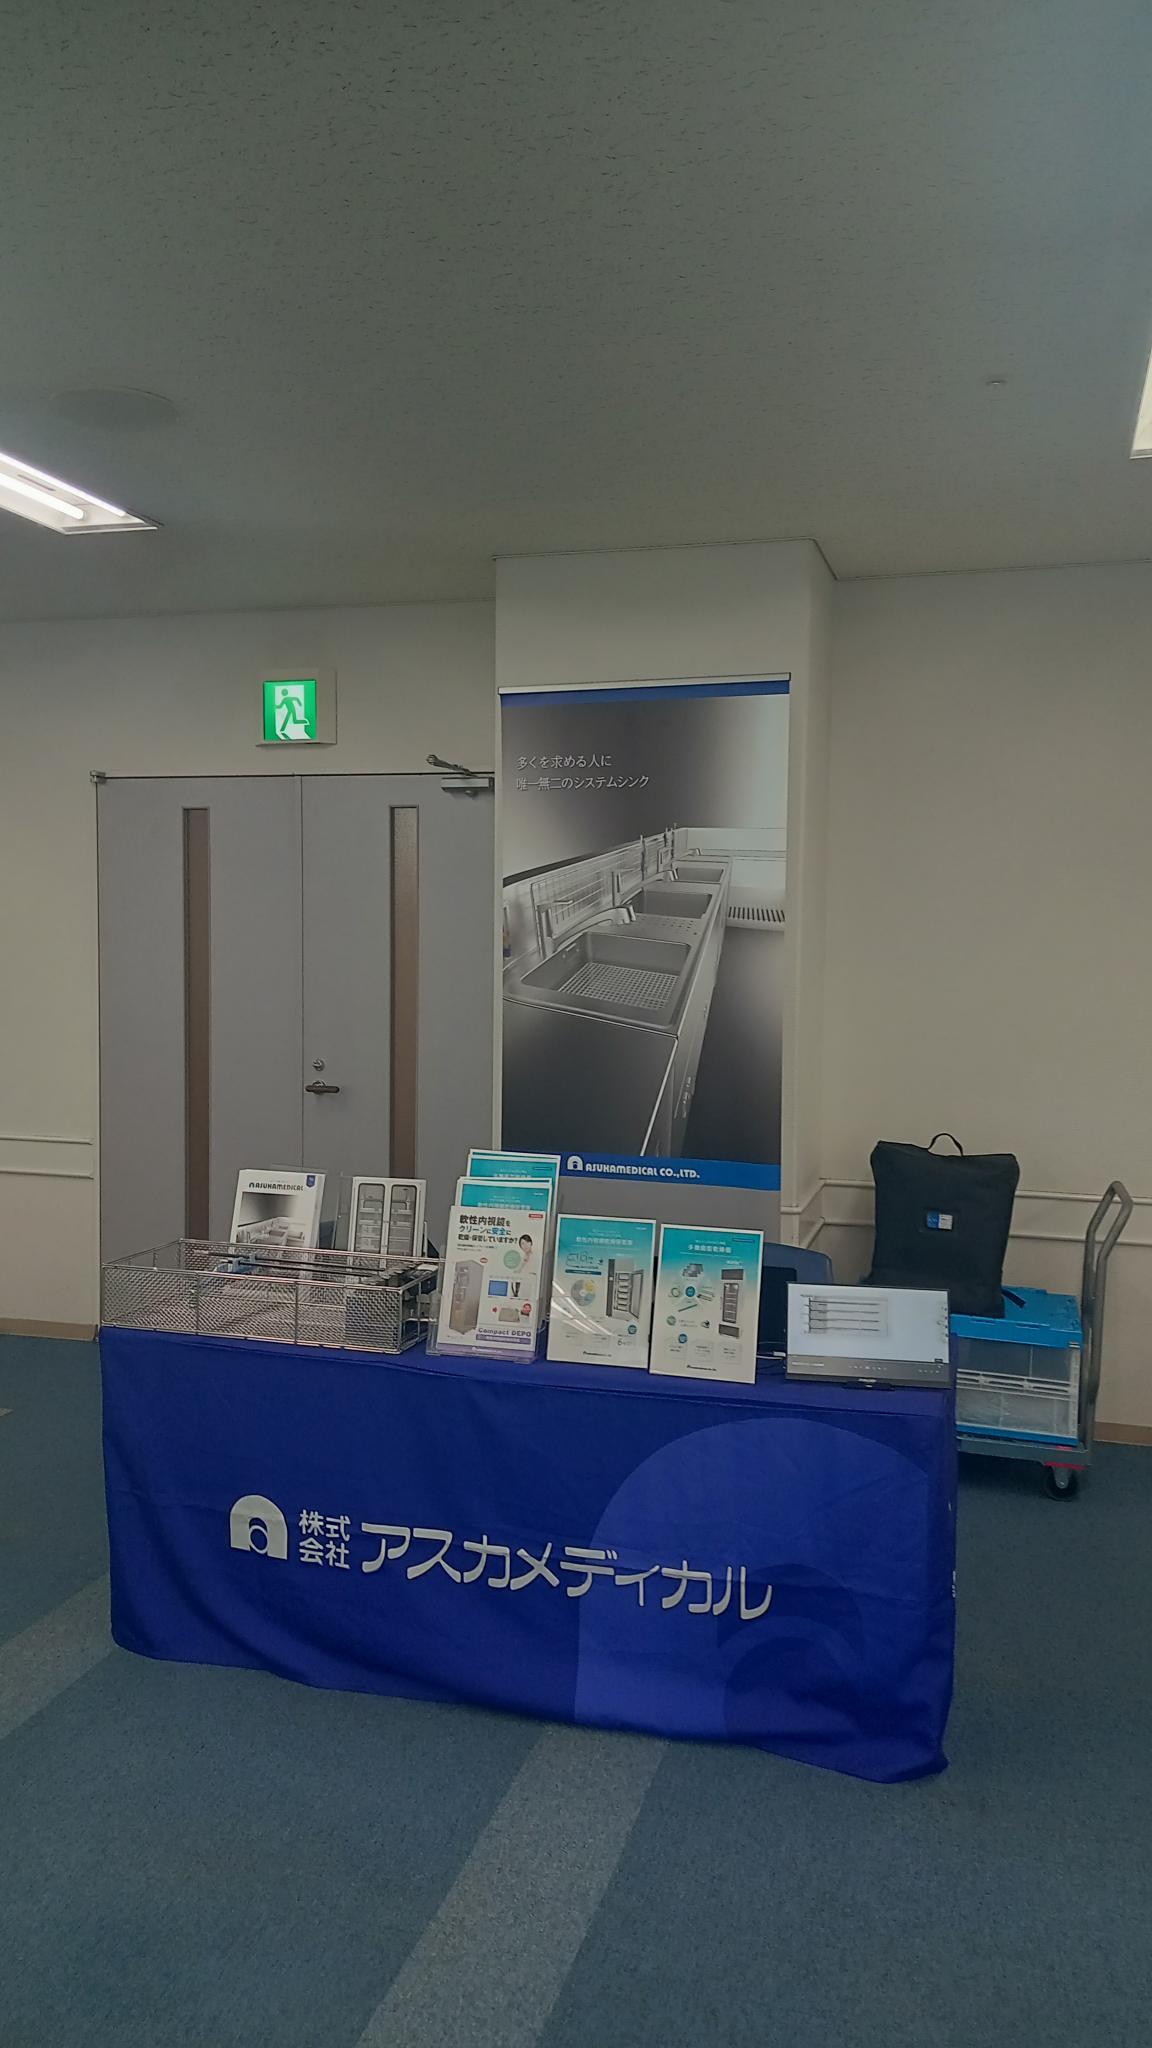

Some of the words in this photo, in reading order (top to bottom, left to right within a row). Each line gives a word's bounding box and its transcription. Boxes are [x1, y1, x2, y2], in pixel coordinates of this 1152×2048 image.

[516, 754, 612, 770] 多くを求める人に
[516, 775, 650, 791] 唯一無二のシステムシンク
[585, 1163, 658, 1177] ASUKAMEDICAL
[659, 1167, 701, 1179] CO.,LTD.
[478, 1326, 510, 1336] Compact
[511, 1329, 532, 1337] DEPO
[298, 1508, 351, 1542] 株式
[298, 1540, 351, 1570] 会社
[360, 1521, 773, 1621] アスカメディカル
